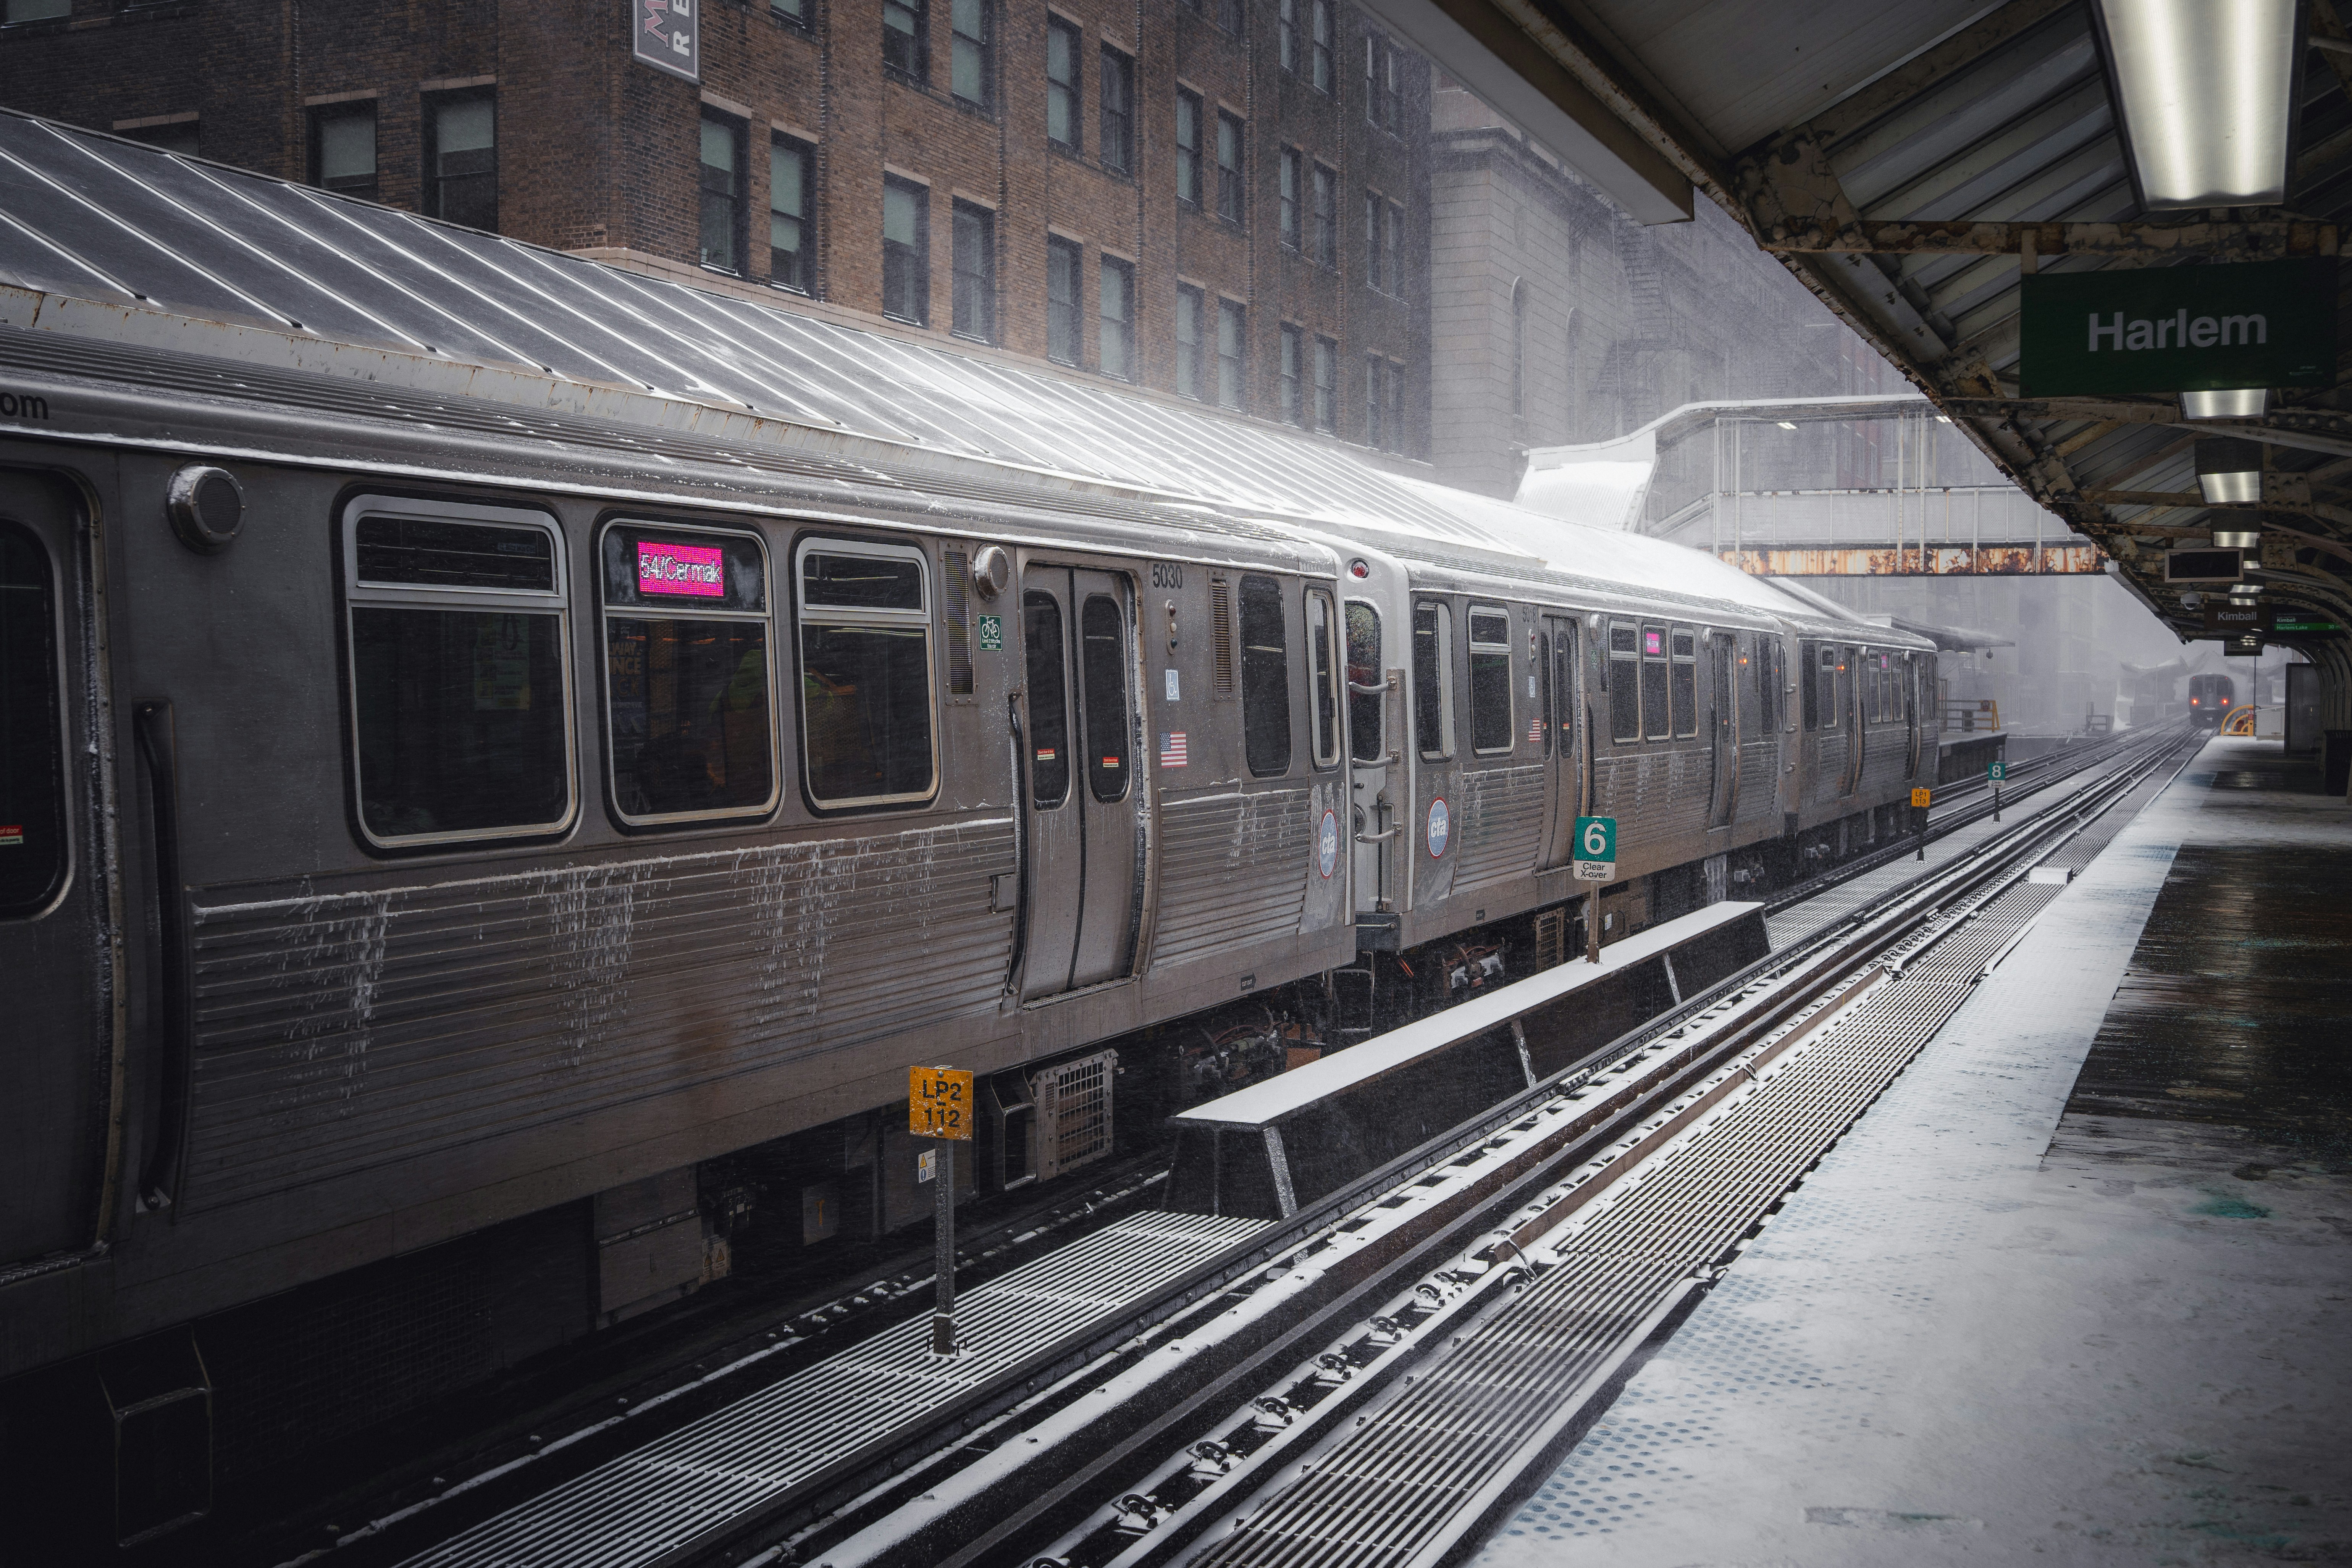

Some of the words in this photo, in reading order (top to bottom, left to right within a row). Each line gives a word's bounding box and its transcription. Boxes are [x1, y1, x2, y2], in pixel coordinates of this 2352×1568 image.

[2088, 308, 2267, 352] Harlem
[0, 392, 49, 420] om
[641, 554, 721, 583] 54/Cermak
[1153, 563, 1182, 589] 5030
[2218, 611, 2257, 621] Kimball
[1992, 765, 2001, 778] 8
[1431, 817, 1446, 838] cta
[1583, 822, 1607, 855] 6
[1322, 832, 1335, 855] cta
[1580, 870, 1607, 878] X-over
[1583, 862, 1605, 871] Clear
[922, 1079, 961, 1101] LP2
[924, 1107, 960, 1128] 112
